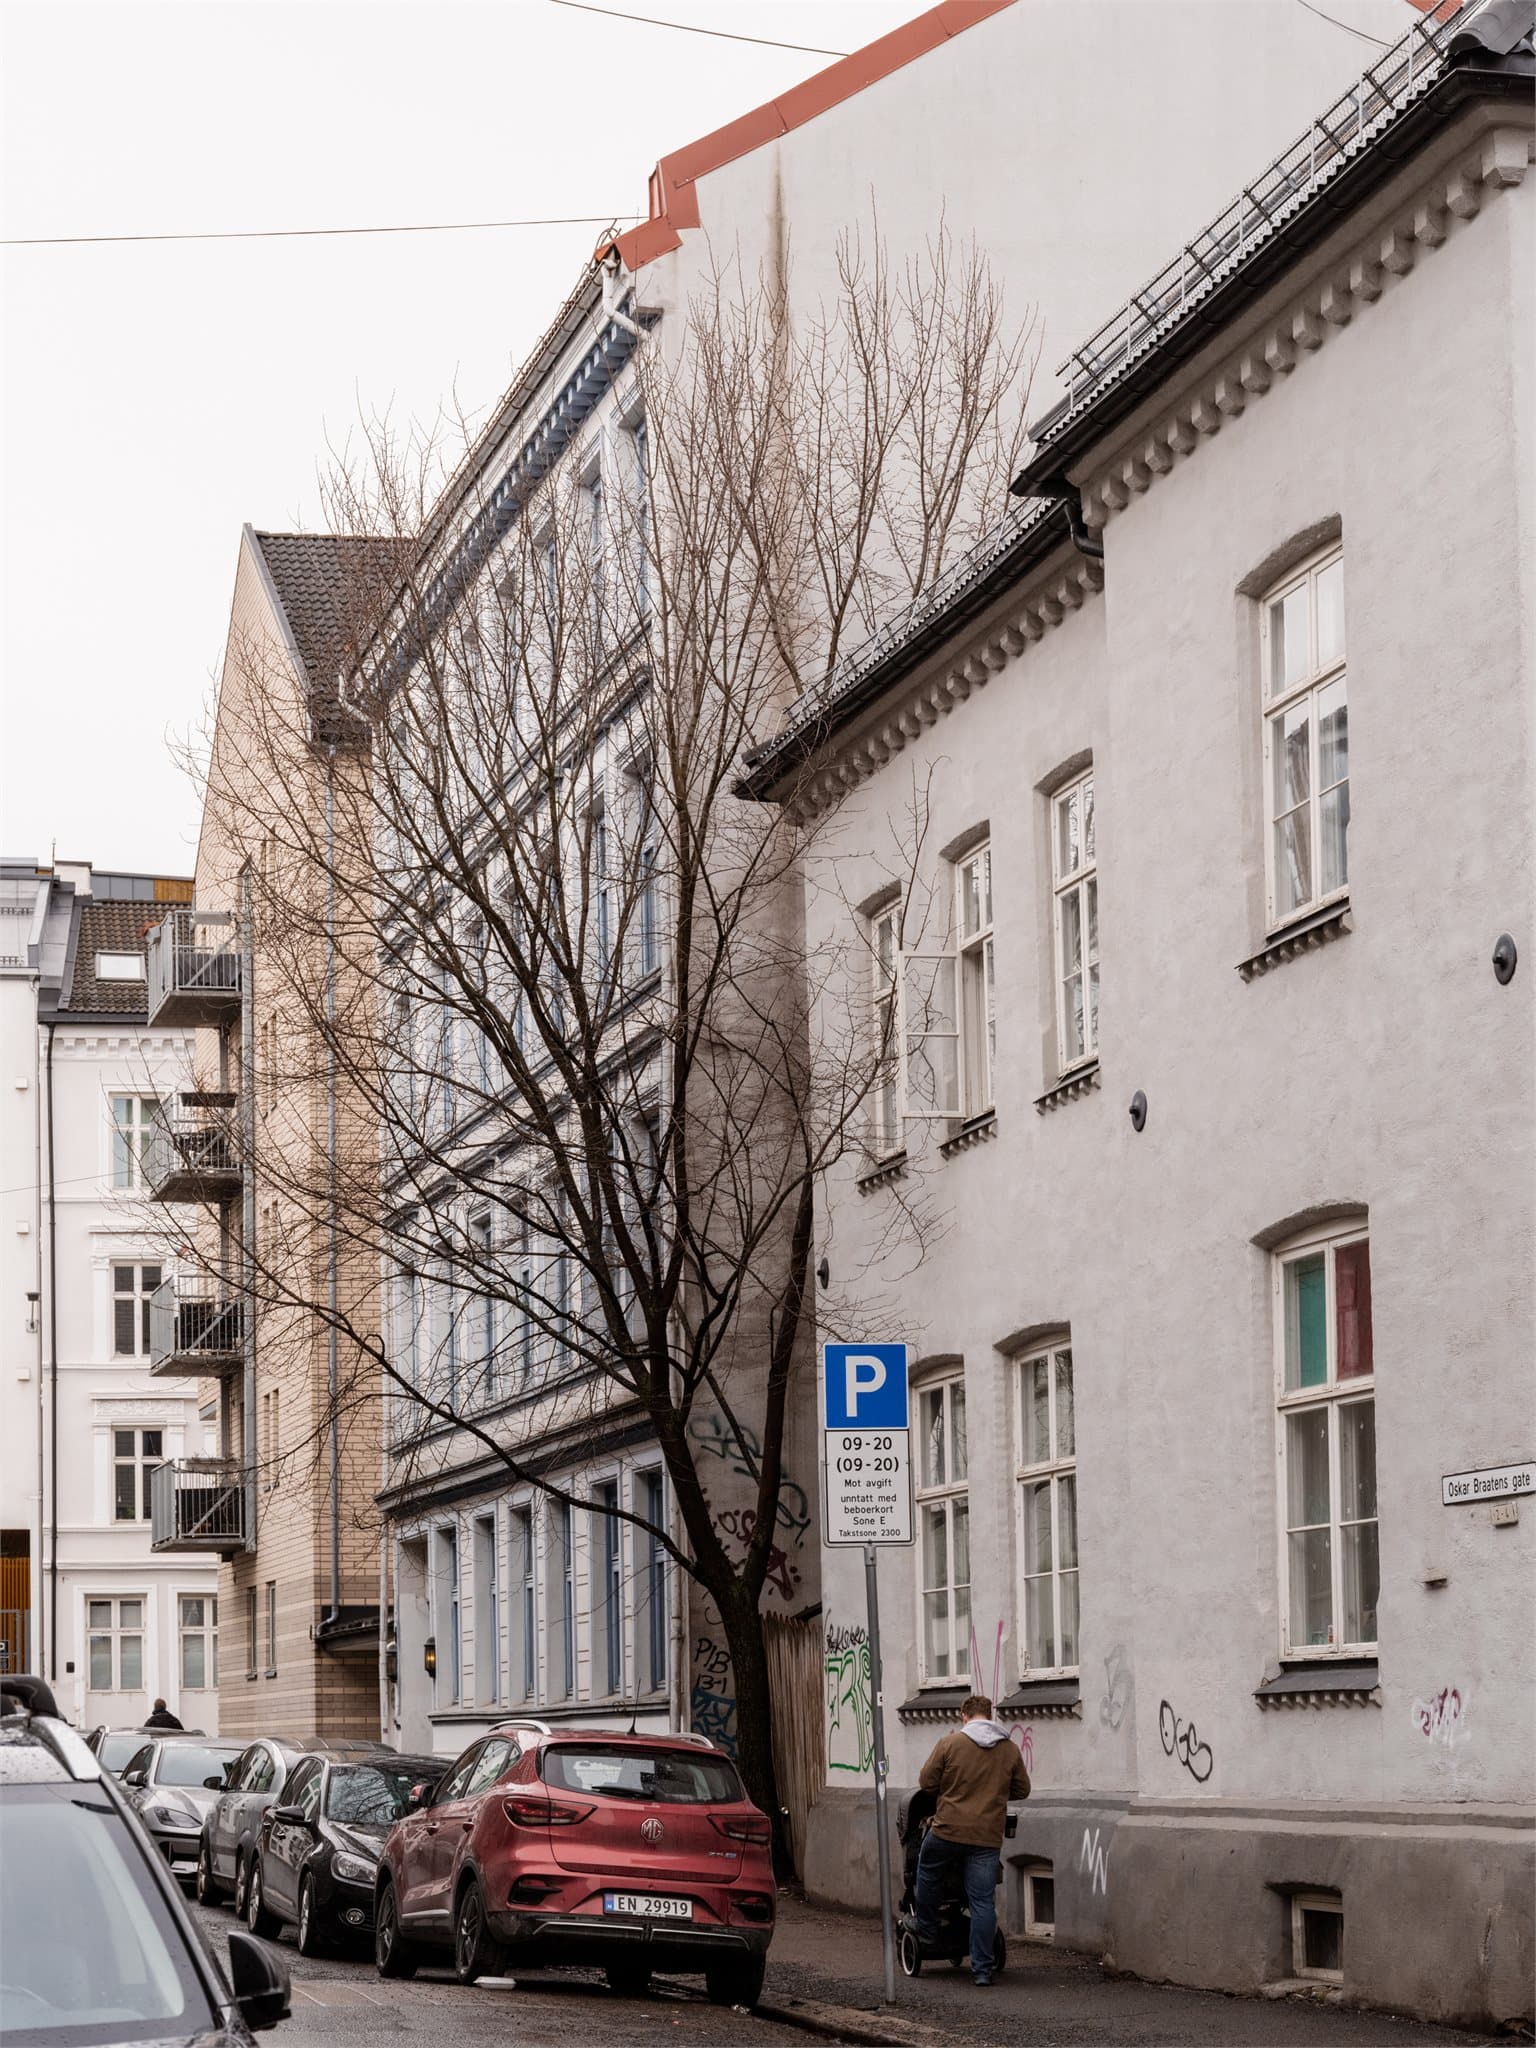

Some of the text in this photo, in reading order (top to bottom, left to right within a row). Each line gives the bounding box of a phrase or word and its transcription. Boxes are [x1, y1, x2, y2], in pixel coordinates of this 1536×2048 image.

[845, 1355, 887, 1417] P
[842, 1436, 892, 1451] 09-20
[836, 1456, 899, 1473] (09-20)
[844, 1478, 892, 1490] Mot avgift
[1448, 1471, 1531, 1497] Oskar Braatens gate
[840, 1494, 897, 1503] unntatt med
[844, 1505, 893, 1514] beboerkort
[853, 1516, 886, 1525] Sone E
[839, 1528, 901, 1537] Takstsone 2300
[642, 1819, 663, 1840] MG
[617, 1896, 688, 1915] EN 29919
